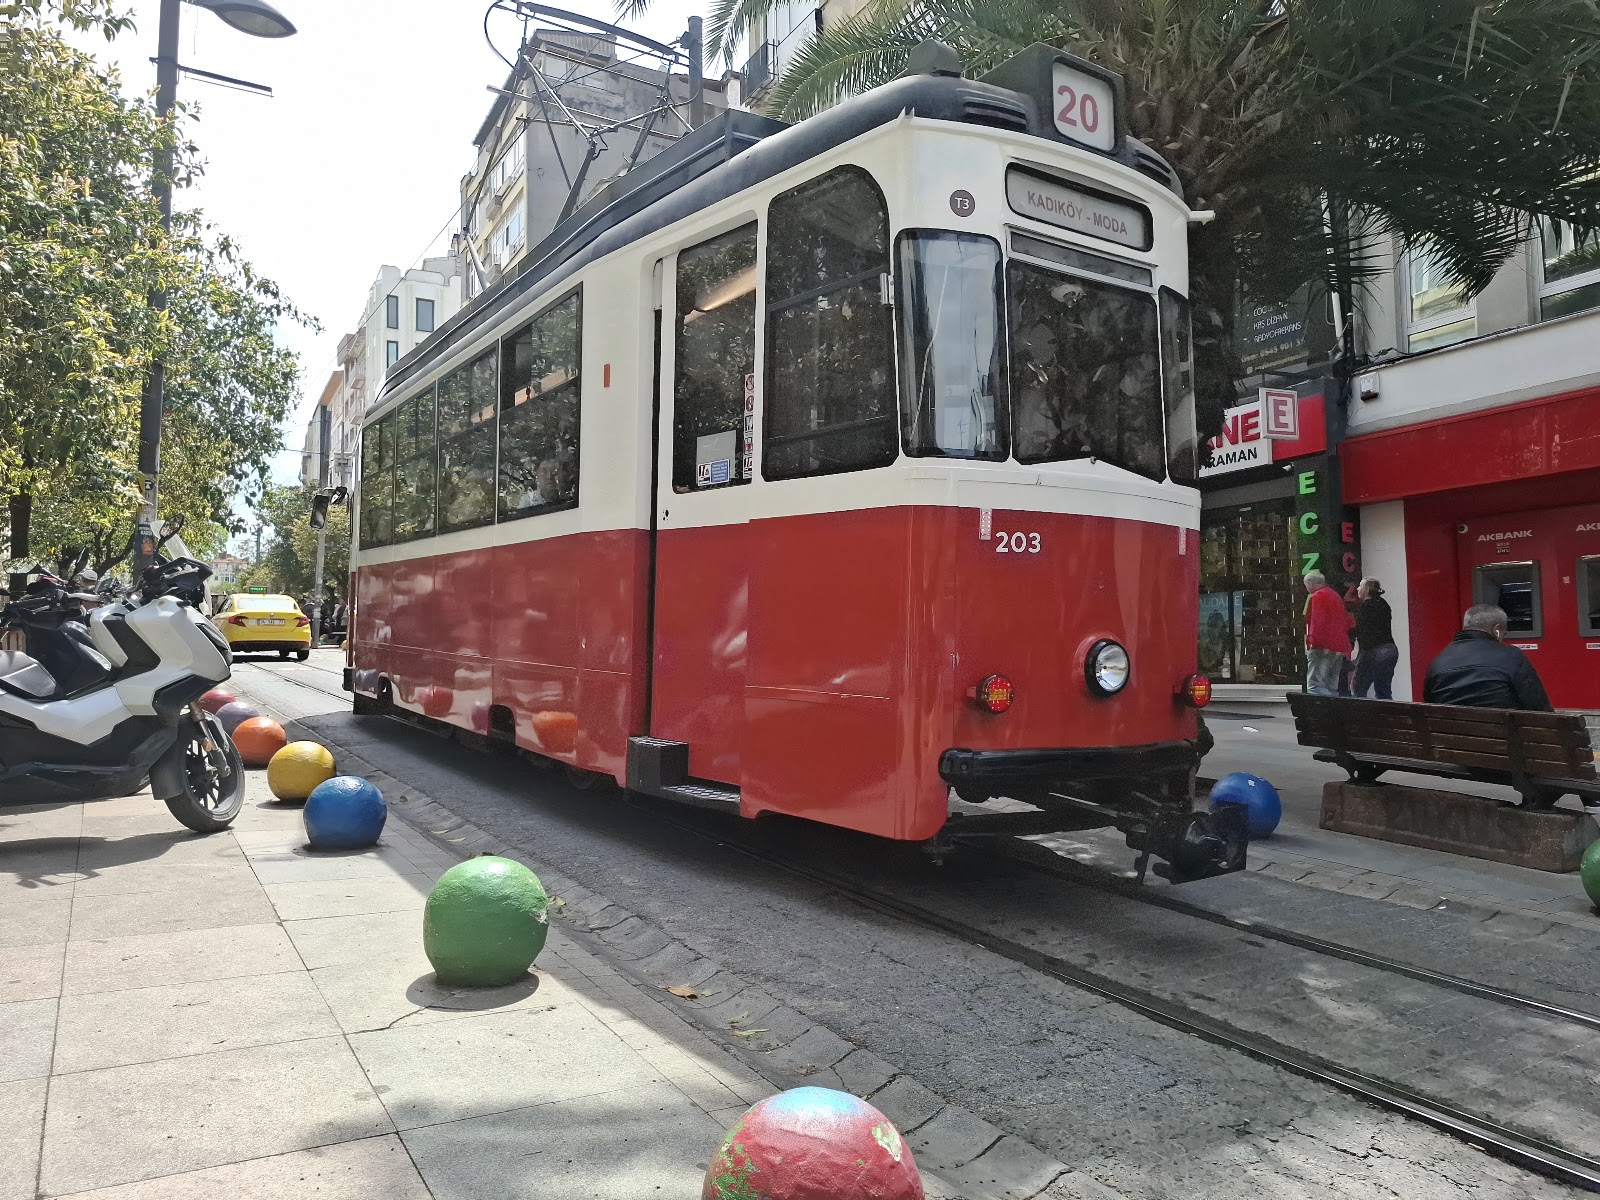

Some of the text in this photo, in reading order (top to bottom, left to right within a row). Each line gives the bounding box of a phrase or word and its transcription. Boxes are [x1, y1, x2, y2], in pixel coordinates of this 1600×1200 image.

[1057, 84, 1099, 133] 20
[954, 197, 970, 210] T3
[1027, 190, 1083, 221] KADIKÖY
[1093, 212, 1128, 236] MODA
[1207, 409, 1261, 449] NE
[1273, 398, 1289, 429] E
[995, 531, 1042, 554] 203
[1298, 470, 1321, 615] ECZ
[1477, 529, 1533, 542] AKBANK
